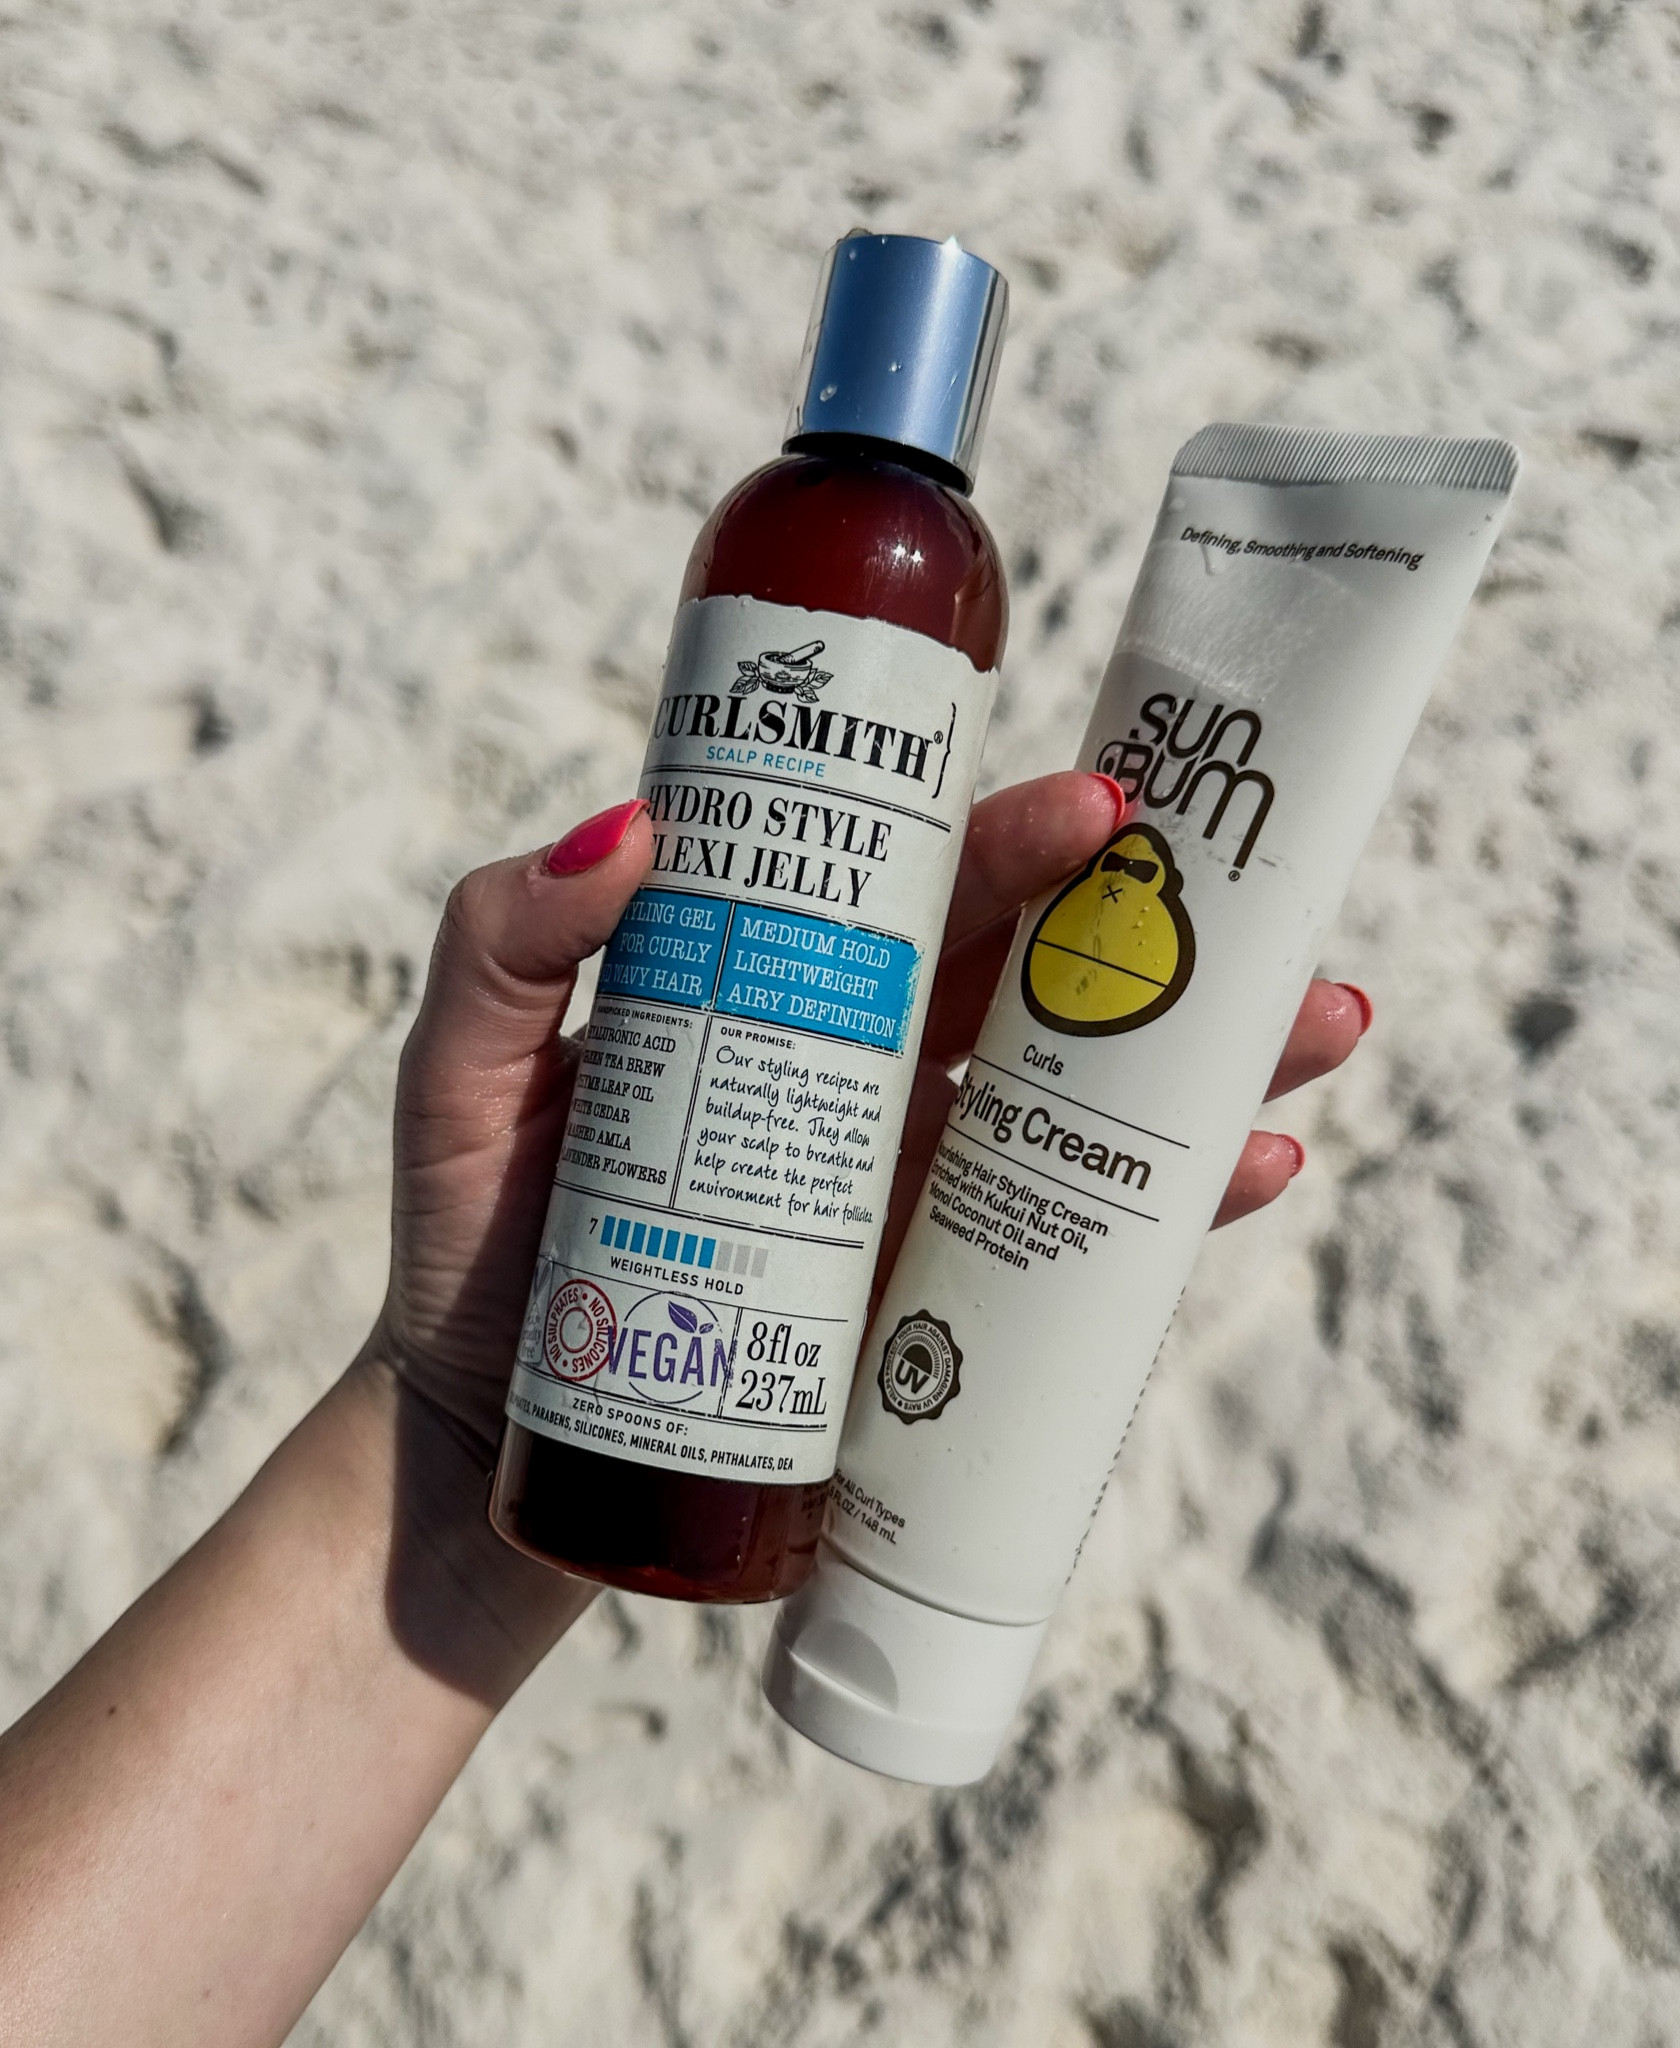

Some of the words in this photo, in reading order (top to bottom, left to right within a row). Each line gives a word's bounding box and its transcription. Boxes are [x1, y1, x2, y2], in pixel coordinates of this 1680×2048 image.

[1180, 526, 1242, 555] Defining,
[1243, 540, 1315, 562] Smoothing
[1316, 541, 1344, 558] and
[1343, 543, 1424, 572] Softening
[706, 745, 758, 764] SCALP
[763, 752, 827, 778] RECIPE
[647, 784, 753, 830] HYDRO
[763, 797, 892, 862] STYLE
[652, 833, 738, 881] LEXI
[743, 846, 873, 909] JELLY
[623, 900, 676, 925] TYLING
[679, 906, 716, 932] GEL
[619, 932, 645, 954] FOR
[648, 935, 713, 964] CURLY
[740, 916, 838, 957] MEDIUM
[838, 938, 891, 970] HOLD
[613, 964, 651, 988] WAVY
[651, 968, 704, 997] HAIR
[733, 949, 879, 1001] LIGHTWEIGHT
[631, 1009, 694, 1030] INGREDIENTS:
[726, 982, 786, 1013] AIRY
[786, 994, 897, 1040] DEFINITION
[642, 1034, 677, 1054] ACID
[720, 1026, 743, 1039] OUR
[745, 1031, 797, 1050] PROMISE:
[604, 1052, 624, 1071] TEA
[625, 1056, 667, 1079] BREW
[716, 1045, 754, 1069] Our
[757, 1057, 810, 1088] styling
[816, 1070, 860, 1095] recipes
[861, 1081, 881, 1097] are
[1022, 1043, 1065, 1077] Curls
[600, 1077, 631, 1097] LEAF
[632, 1084, 655, 1103] OIL
[709, 1075, 781, 1108] naturally
[786, 1087, 860, 1122] lightweight
[861, 1105, 882, 1123] and
[593, 1102, 631, 1125] CEDAR
[705, 1096, 799, 1132] buildup-free.
[807, 1116, 840, 1147] They
[843, 1127, 871, 1148] allow
[596, 1129, 632, 1151] AMLA
[696, 1126, 737, 1147] your
[740, 1135, 780, 1160] scalp
[784, 1142, 801, 1159] to
[805, 1143, 854, 1170] breathe
[855, 1156, 876, 1173] and
[1021, 1106, 1152, 1192] Cream
[601, 1156, 668, 1186] FLOWERS
[693, 1148, 726, 1176] help
[731, 1160, 779, 1182] create
[783, 1167, 808, 1187] the
[809, 1174, 854, 1198] perfect
[689, 1177, 783, 1209] environment
[787, 1193, 811, 1217] for
[812, 1199, 841, 1220] hair
[959, 1179, 984, 1202] with
[982, 1193, 1029, 1224] Kukui
[1026, 1210, 1060, 1240] Nut
[1060, 1227, 1089, 1255] Oil,
[972, 1160, 998, 1186] Hair
[996, 1174, 1050, 1217] Styling
[1050, 1200, 1110, 1238] Cream
[588, 1216, 599, 1236] 7
[928, 1204, 976, 1244] Seaweed
[974, 1231, 1030, 1271] Protein
[950, 1197, 1003, 1235] Coconut
[1002, 1222, 1024, 1246] Oil
[1024, 1235, 1061, 1262] and
[609, 1255, 700, 1288] WEIGHTLESS
[703, 1276, 745, 1297] HOLD
[547, 1286, 580, 1344] SULPHATES
[588, 1296, 606, 1318] NO
[912, 1321, 929, 1332] HAIR
[549, 1343, 564, 1364] NO
[571, 1316, 610, 1374] SILICONES
[606, 1324, 738, 1389] VEGAN
[793, 1340, 823, 1369] oz
[927, 1326, 951, 1358] AGAINST
[734, 1368, 829, 1416] 237mL
[894, 1357, 931, 1395] UV
[933, 1356, 952, 1401] DAMAGING
[571, 1397, 604, 1417] ZERO
[606, 1406, 662, 1430] SPOONS
[665, 1420, 690, 1436] OF:
[903, 1401, 923, 1412] RAYS
[922, 1398, 935, 1410] UV
[531, 1403, 572, 1432] PARABENS,
[573, 1418, 628, 1447] SILICONES,
[629, 1433, 678, 1457] MINERAL
[680, 1445, 708, 1464] OILS,
[710, 1450, 776, 1472] PHTHALATES,
[776, 1457, 795, 1472] DEA
[841, 1498, 856, 1517] OZ
[860, 1512, 880, 1533] 148
[878, 1526, 897, 1546] mL
[844, 1479, 857, 1496] All
[854, 1487, 876, 1510] Curl
[875, 1499, 907, 1528] Types
